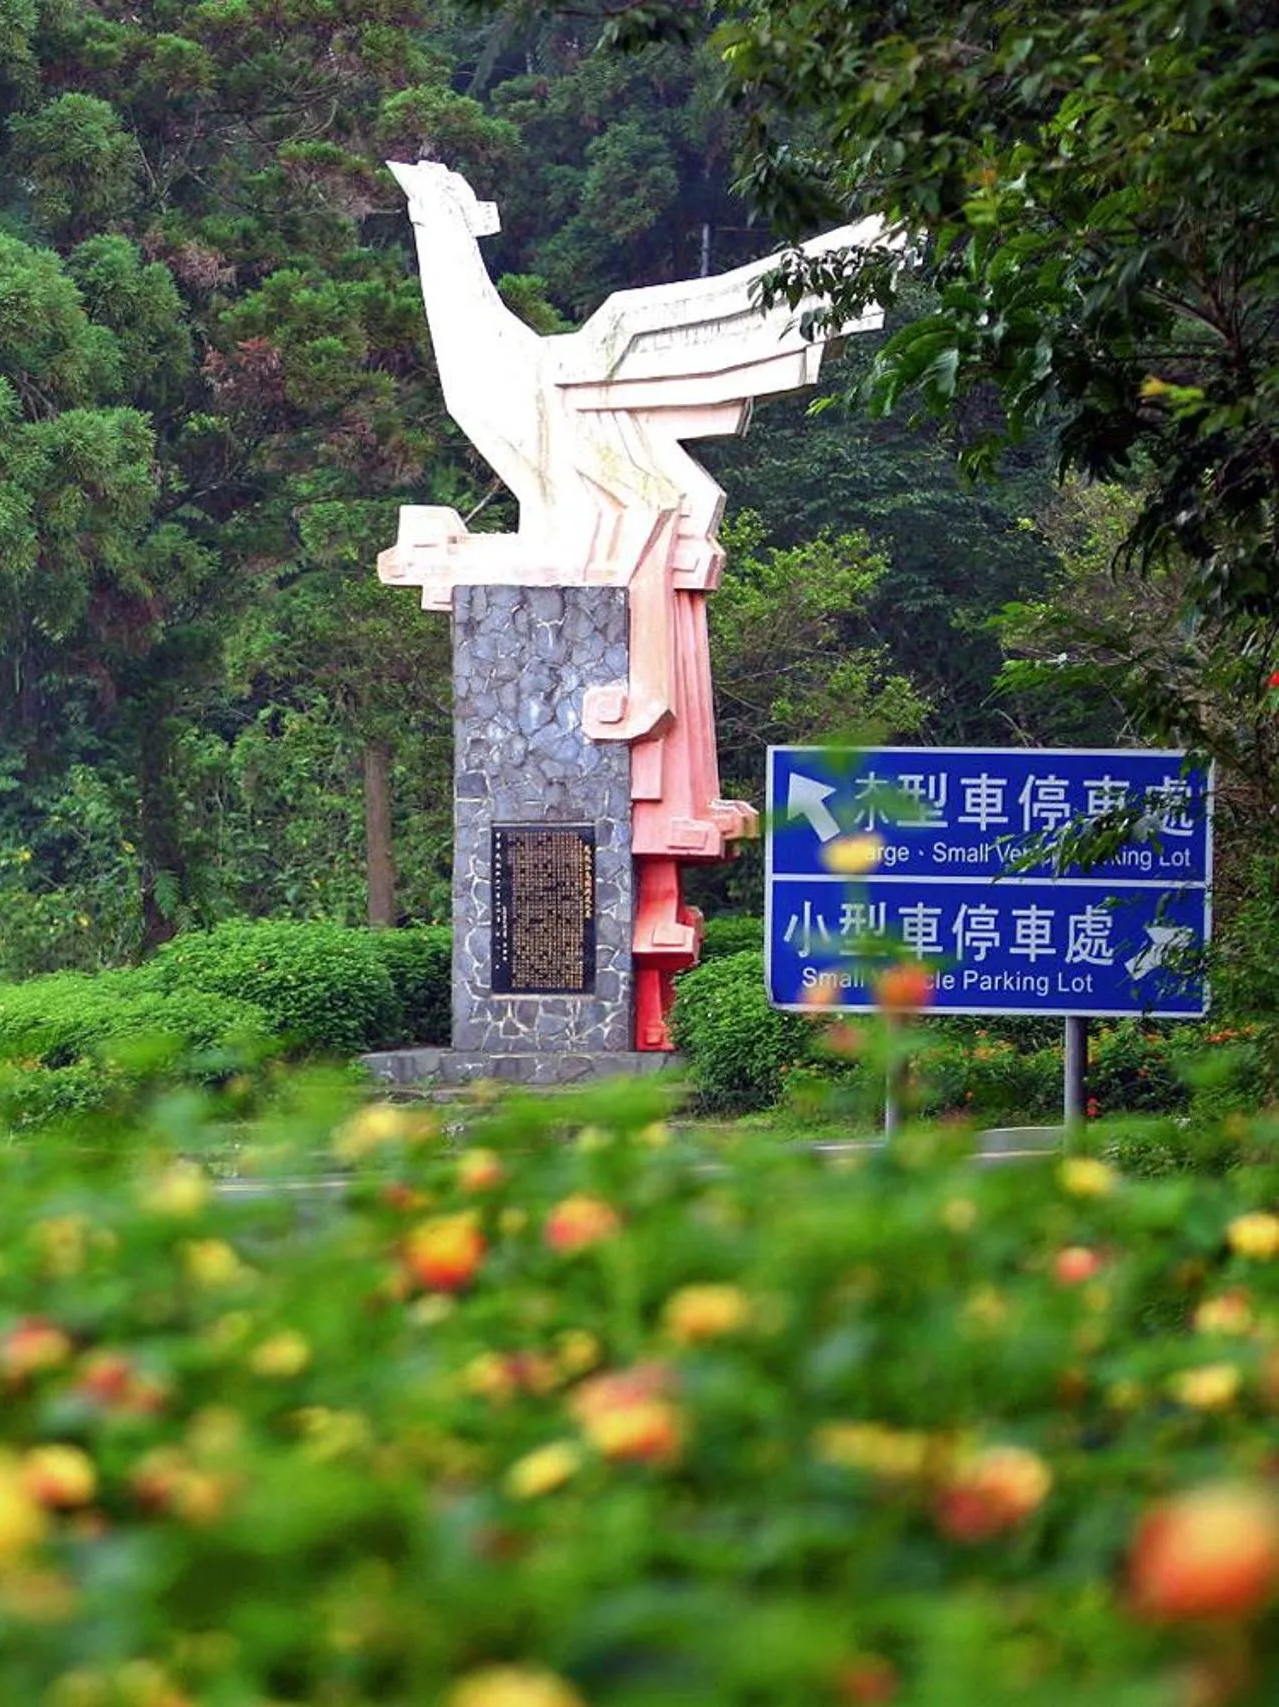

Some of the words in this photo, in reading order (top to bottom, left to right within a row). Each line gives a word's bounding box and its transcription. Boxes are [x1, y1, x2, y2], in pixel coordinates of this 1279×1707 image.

[859, 842, 910, 866] arge
[932, 841, 989, 863] Small
[1159, 847, 1190, 867] Lot
[783, 901, 1114, 966] 小型車停車處
[801, 967, 864, 989] Small
[963, 969, 1049, 996] Parking
[1058, 972, 1094, 993] Lot
